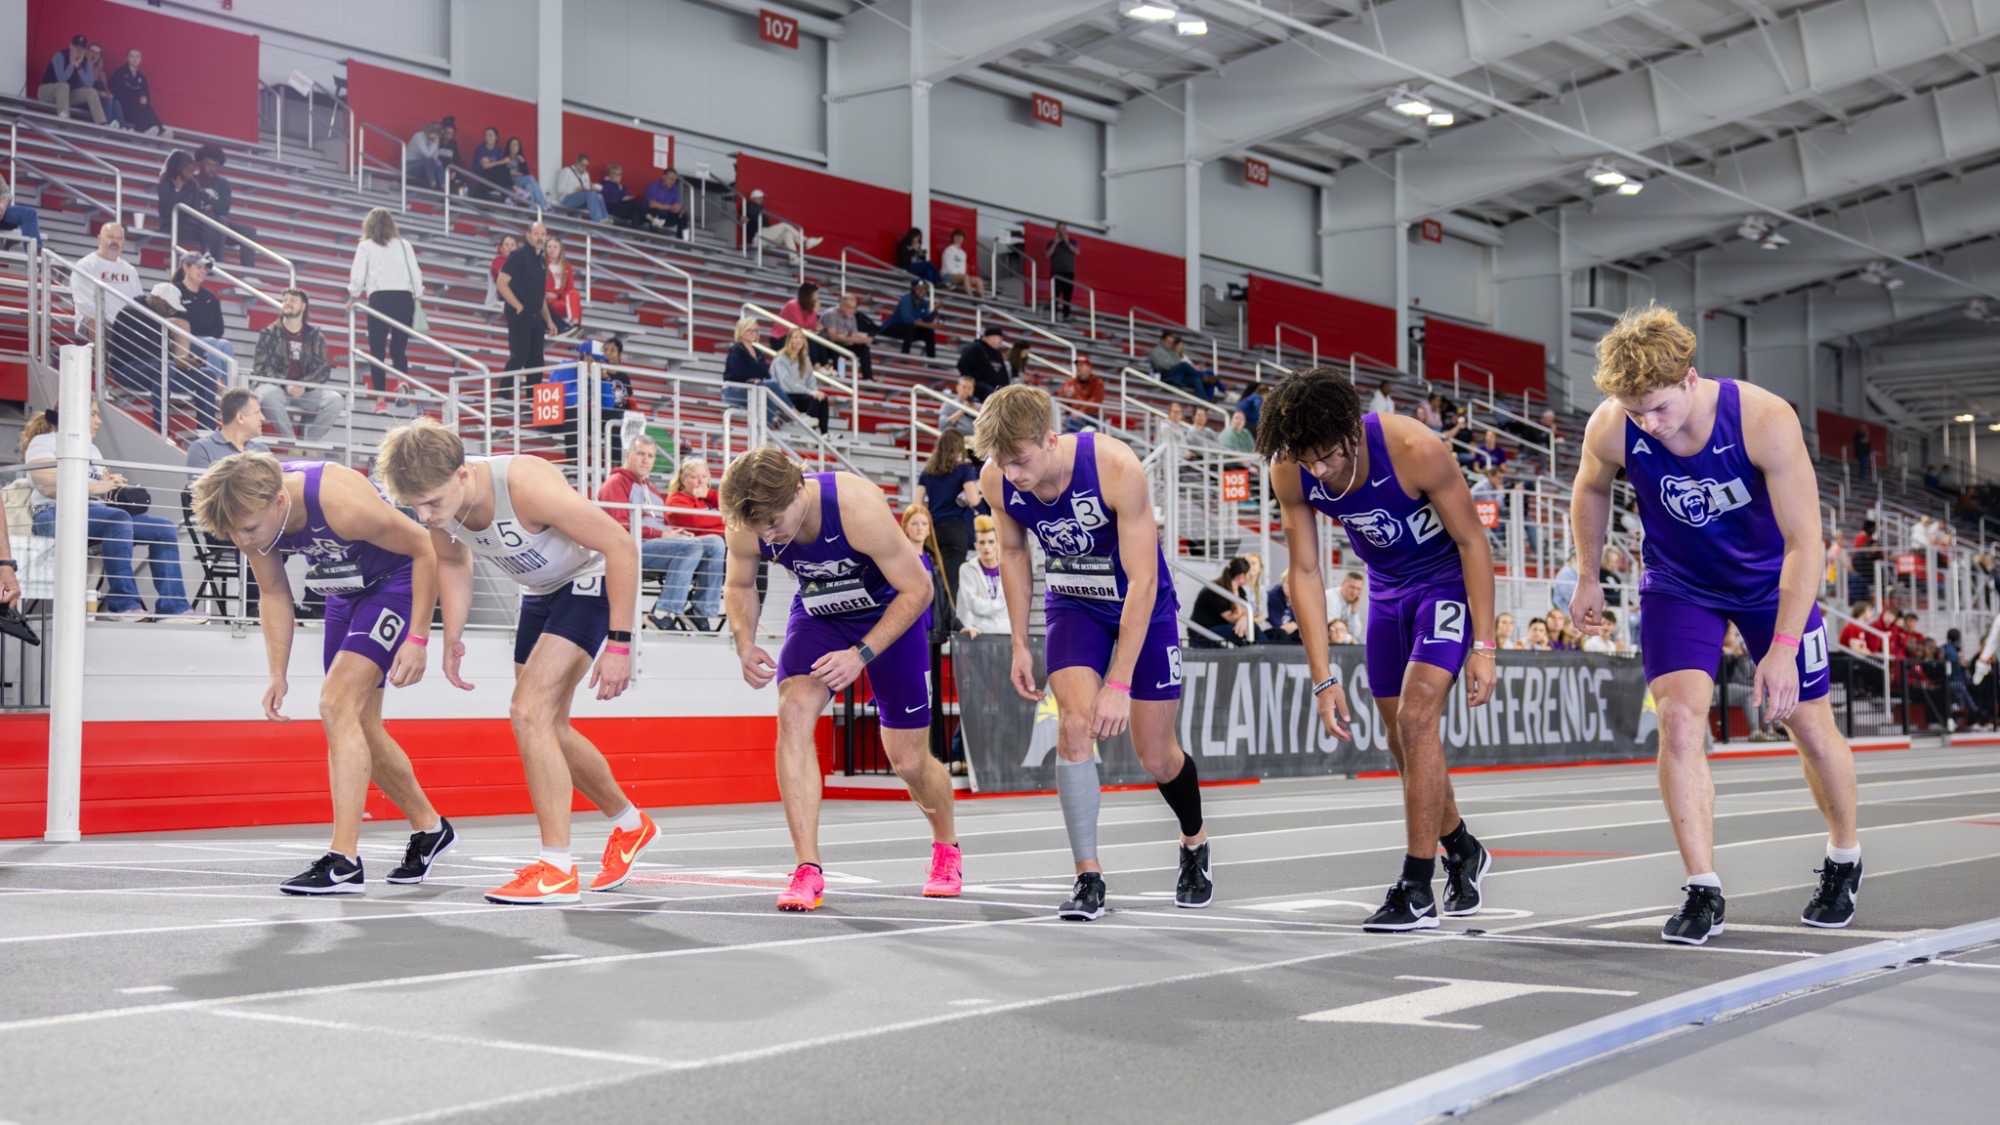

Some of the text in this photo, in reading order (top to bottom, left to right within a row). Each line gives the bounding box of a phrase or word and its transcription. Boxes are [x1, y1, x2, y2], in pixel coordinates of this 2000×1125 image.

[764, 16, 793, 41] 107
[1036, 99, 1059, 121] 108
[1247, 162, 1267, 182] 109
[537, 388, 559, 403] 104
[537, 405, 559, 420] 105
[1225, 474, 1245, 486] 105
[1225, 486, 1245, 498] 106
[1718, 485, 1742, 507] 1
[1075, 499, 1101, 527] 3
[1412, 507, 1439, 538] 2
[1480, 515, 1496, 525] 07
[496, 521, 523, 548] 5
[1050, 585, 1115, 597] ANDERSON
[809, 596, 872, 615] DUGGER
[379, 613, 401, 642] 6
[1438, 602, 1462, 635] 2
[1810, 633, 1824, 665] 1
[1440, 666, 1614, 749] ONFERENCE
